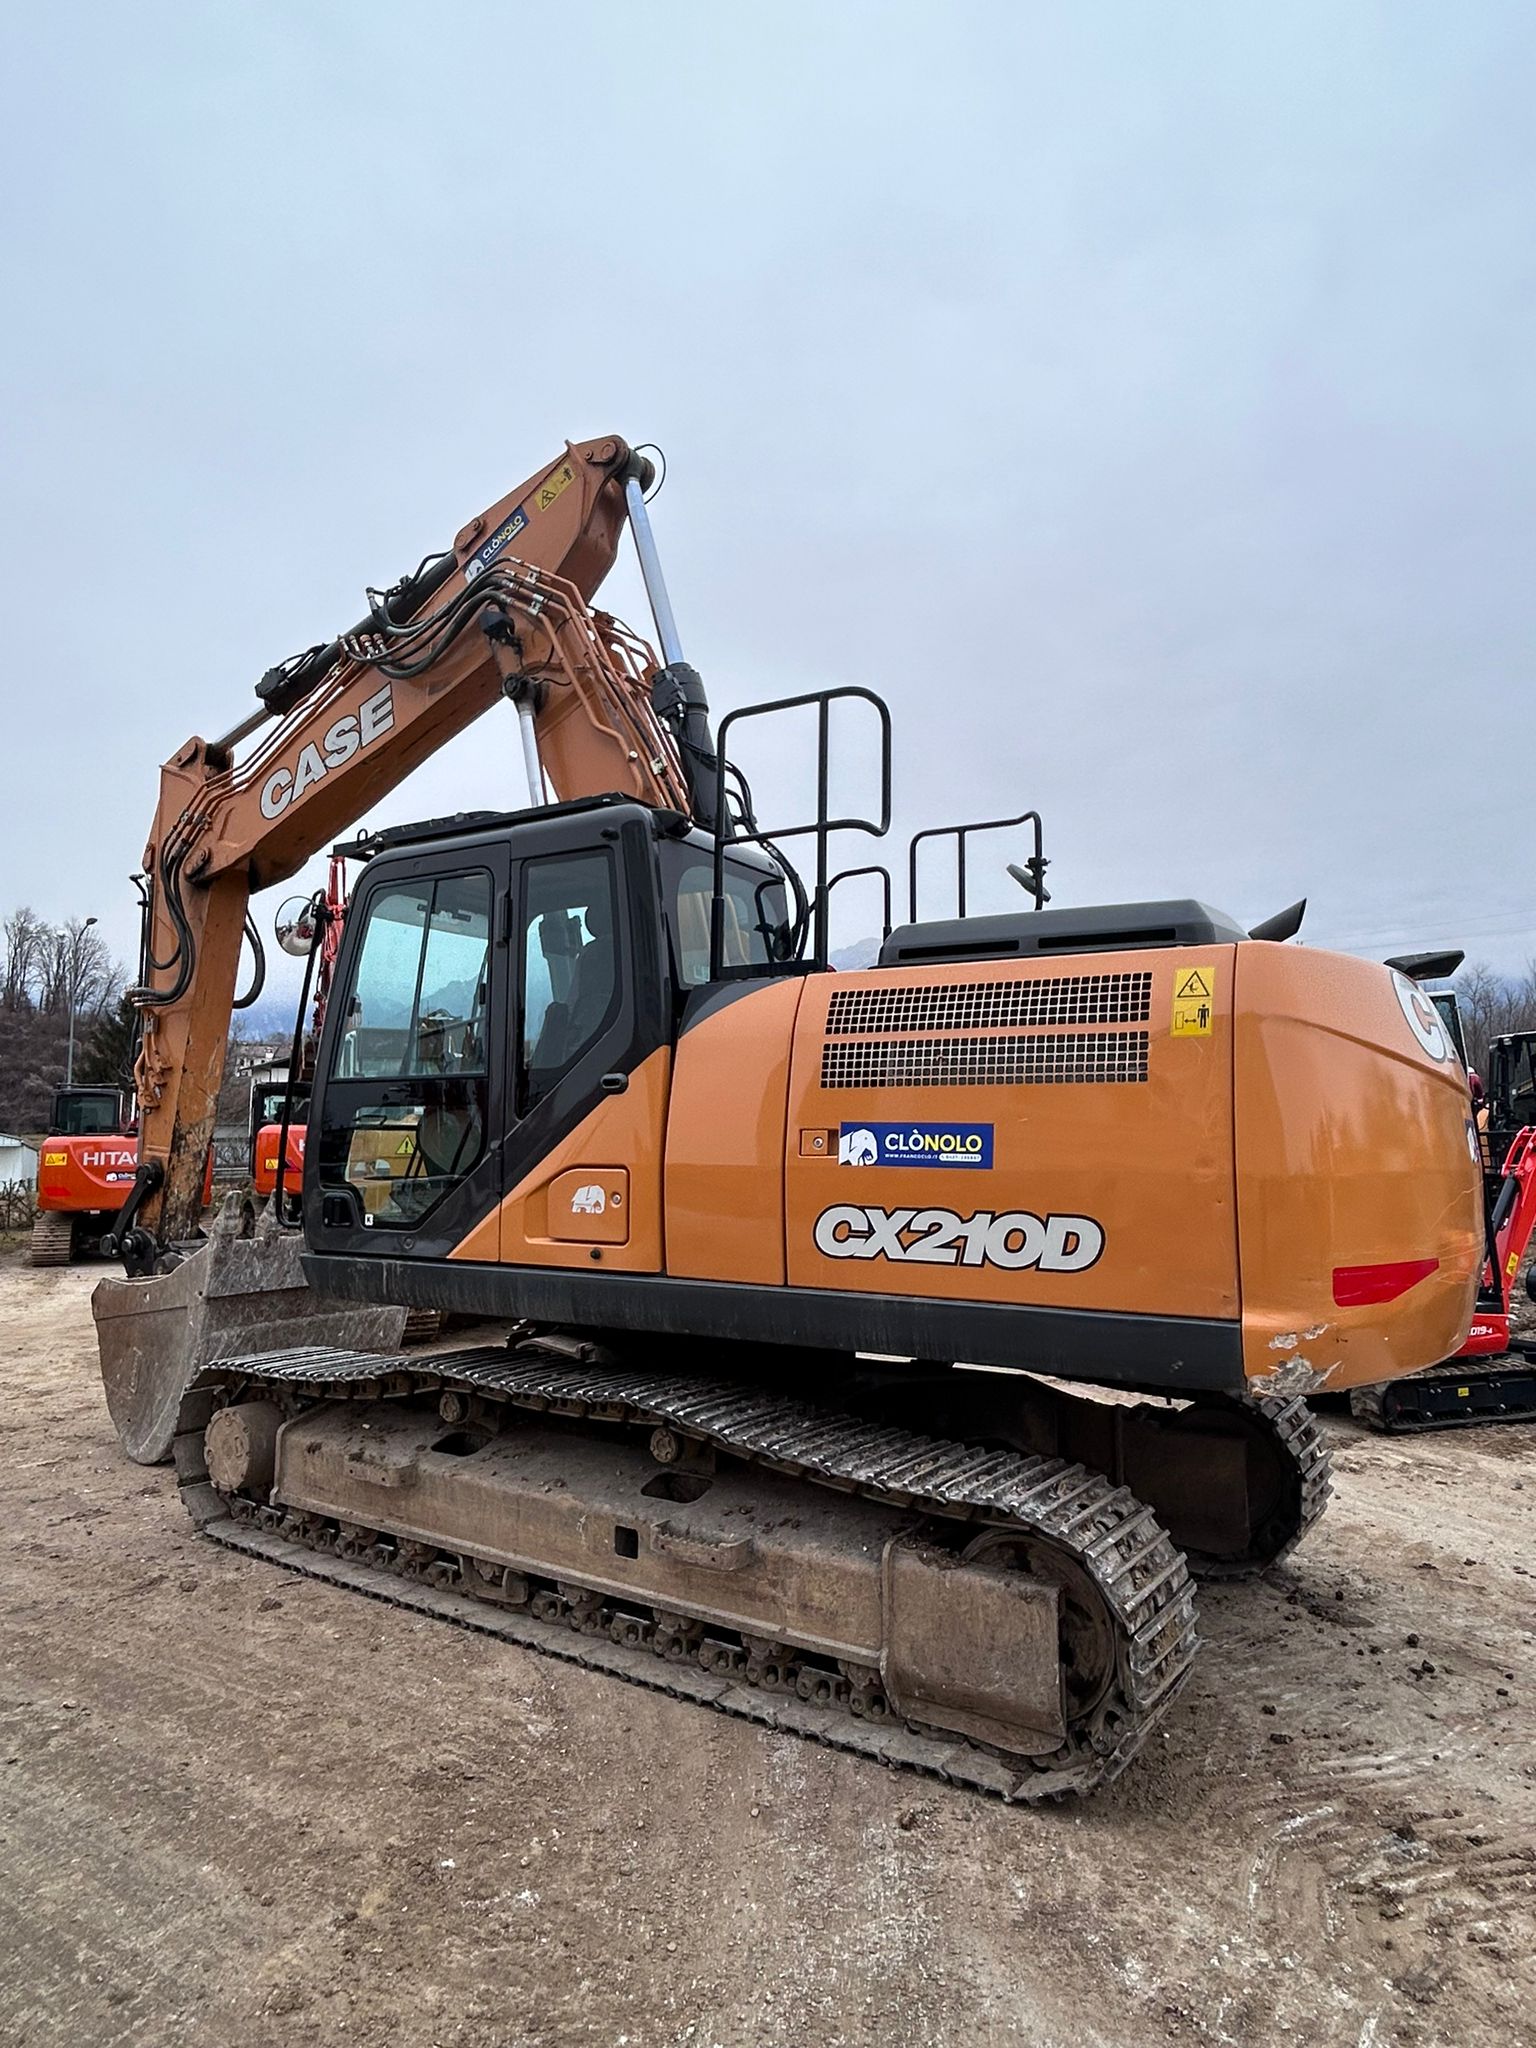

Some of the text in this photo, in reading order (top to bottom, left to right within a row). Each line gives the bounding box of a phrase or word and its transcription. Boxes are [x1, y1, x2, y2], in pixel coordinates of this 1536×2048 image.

[483, 515, 522, 559] CLÒNOLO
[260, 681, 396, 820] CASE
[885, 1129, 982, 1152] CLÒNOLO
[813, 1203, 1106, 1272] CX210D
